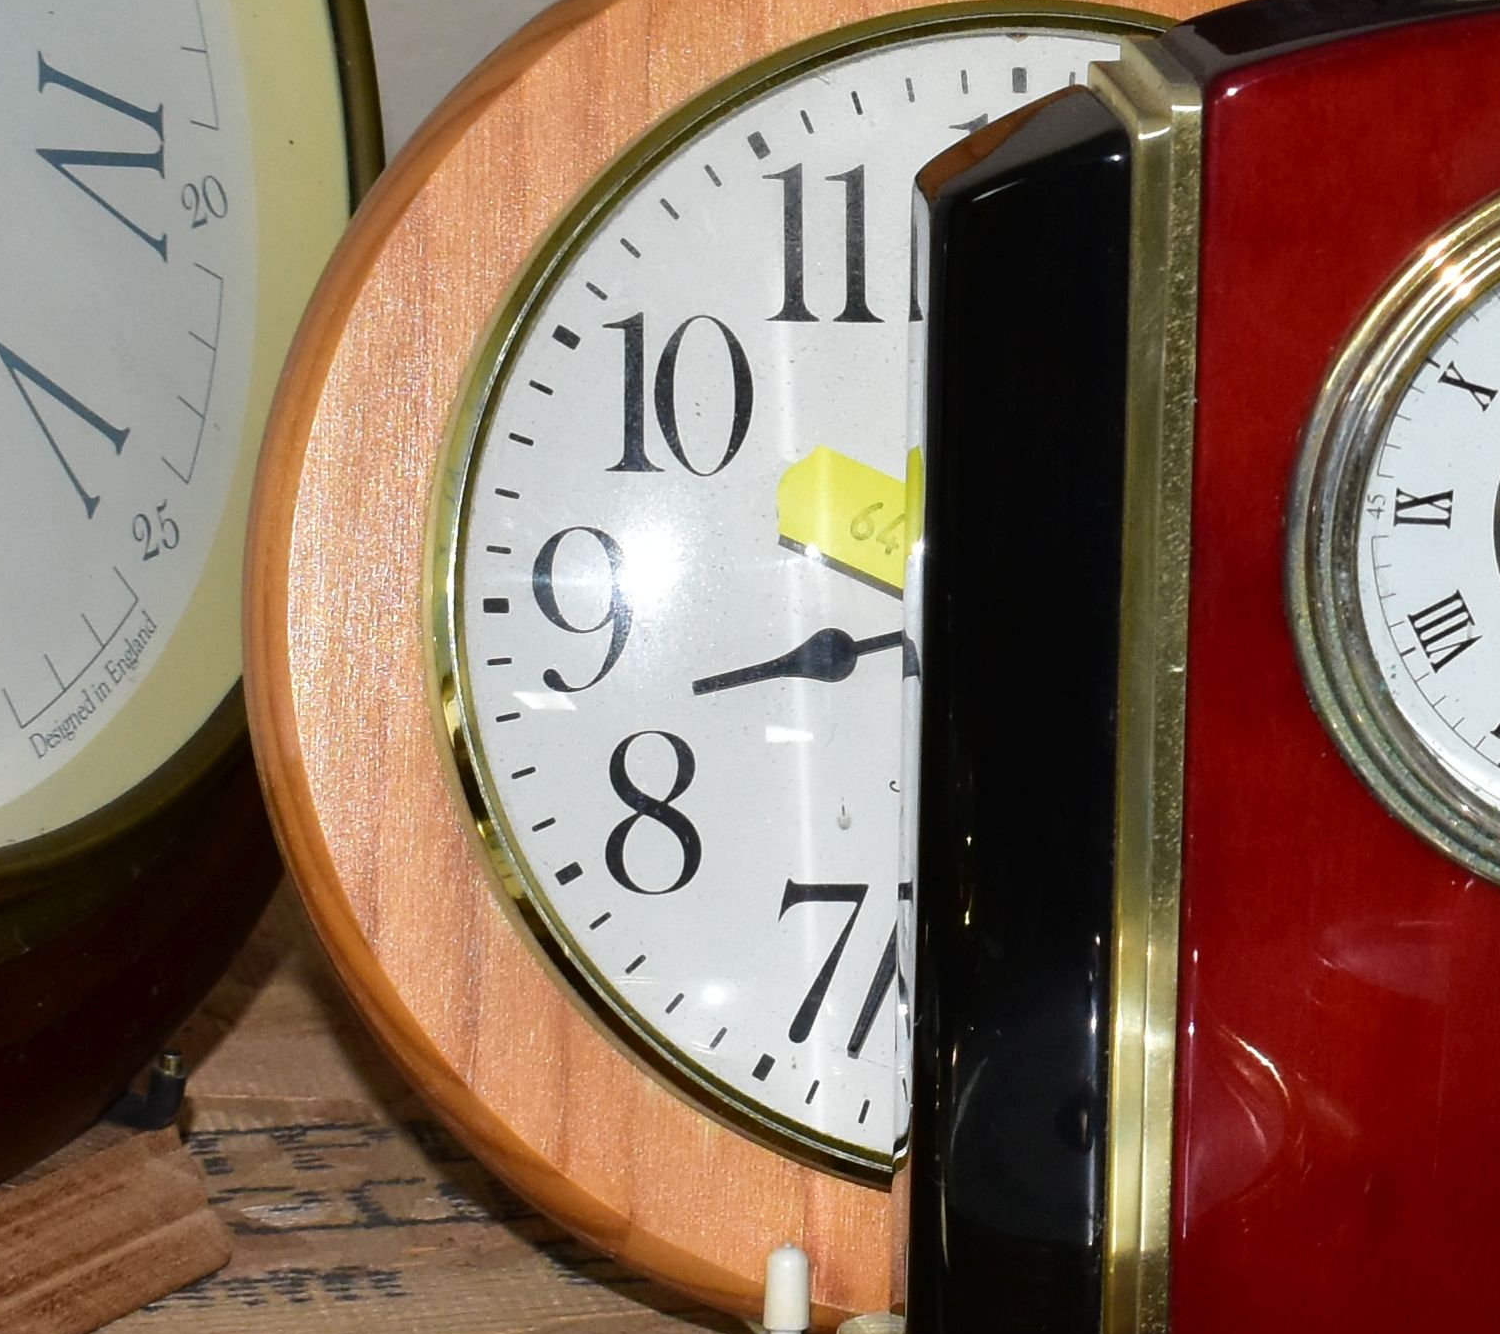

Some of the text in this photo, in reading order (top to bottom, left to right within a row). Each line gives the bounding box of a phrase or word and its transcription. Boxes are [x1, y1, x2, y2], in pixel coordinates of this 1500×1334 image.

[36, 50, 168, 263] IV
[181, 175, 228, 228] 20
[762, 163, 885, 323] 11
[602, 312, 754, 477] 10
[1439, 360, 1499, 411] X
[131, 499, 180, 562] 25
[850, 502, 906, 556] 64
[1365, 493, 1385, 519] 45
[1393, 487, 1454, 530] IX
[532, 526, 634, 692] 9
[1407, 590, 1483, 673] VIII
[28, 611, 159, 759] Designed in England
[605, 730, 701, 895] 8
[778, 879, 869, 1044] 7
